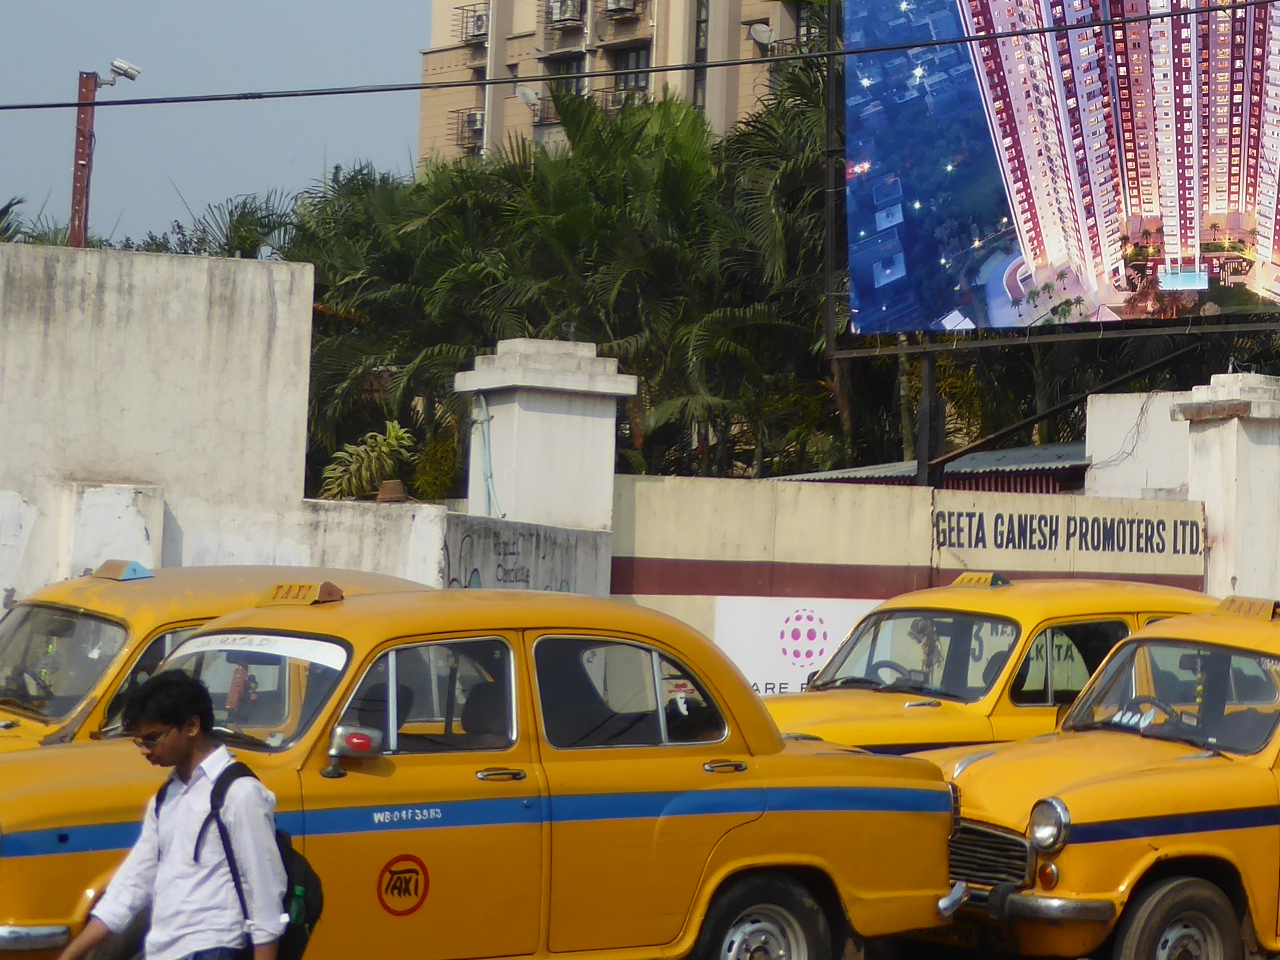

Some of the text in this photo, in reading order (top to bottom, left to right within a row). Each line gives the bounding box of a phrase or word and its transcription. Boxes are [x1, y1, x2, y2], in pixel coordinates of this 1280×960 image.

[936, 511, 987, 549] GEETA
[994, 514, 1059, 550] GANESH
[1066, 516, 1165, 554] PROMOTERS
[272, 584, 312, 601] TAXI
[752, 682, 789, 694] ARE
